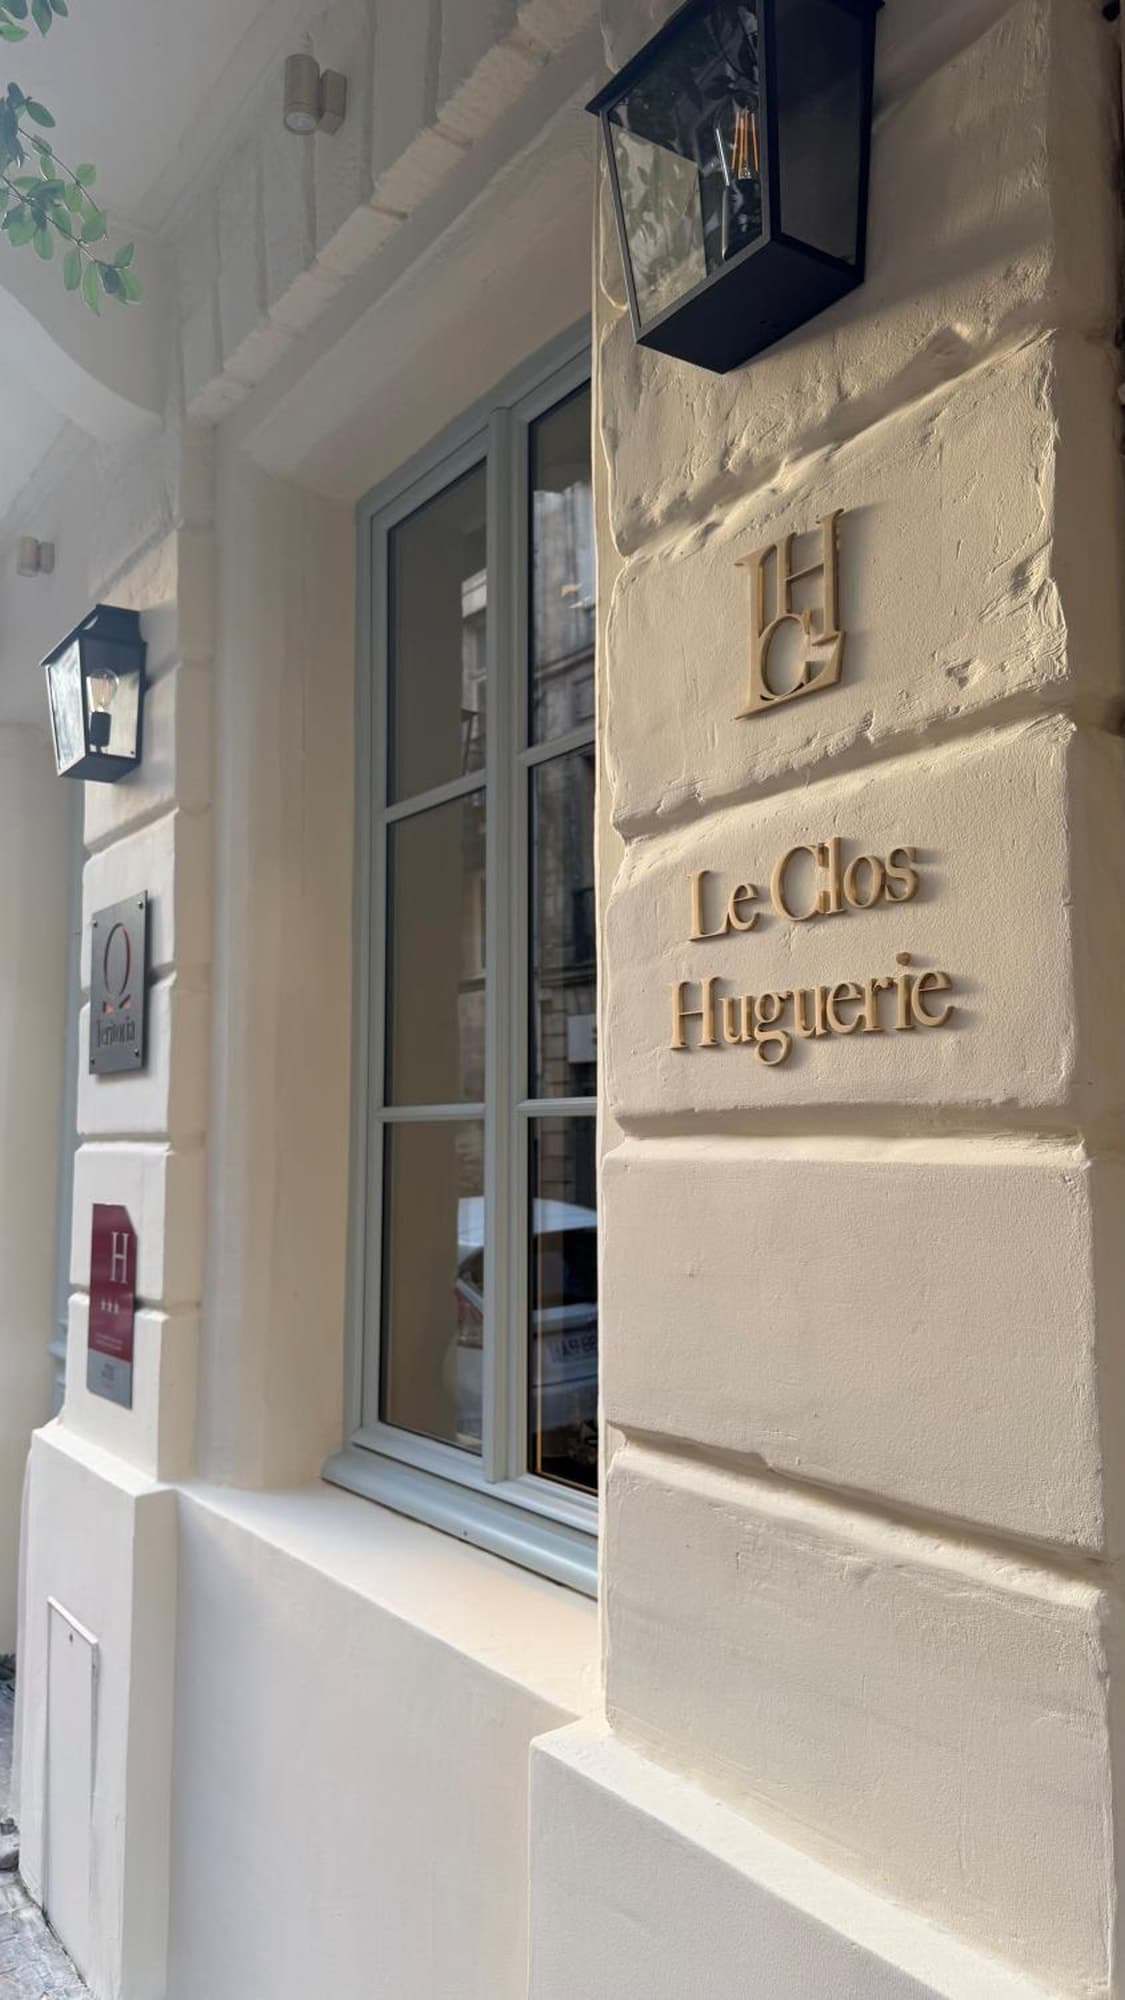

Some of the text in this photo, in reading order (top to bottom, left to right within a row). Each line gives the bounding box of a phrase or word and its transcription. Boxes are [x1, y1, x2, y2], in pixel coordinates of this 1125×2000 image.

[688, 836, 921, 941] Le Clos
[669, 951, 956, 1067] Huguerie
[110, 1231, 129, 1284] H
